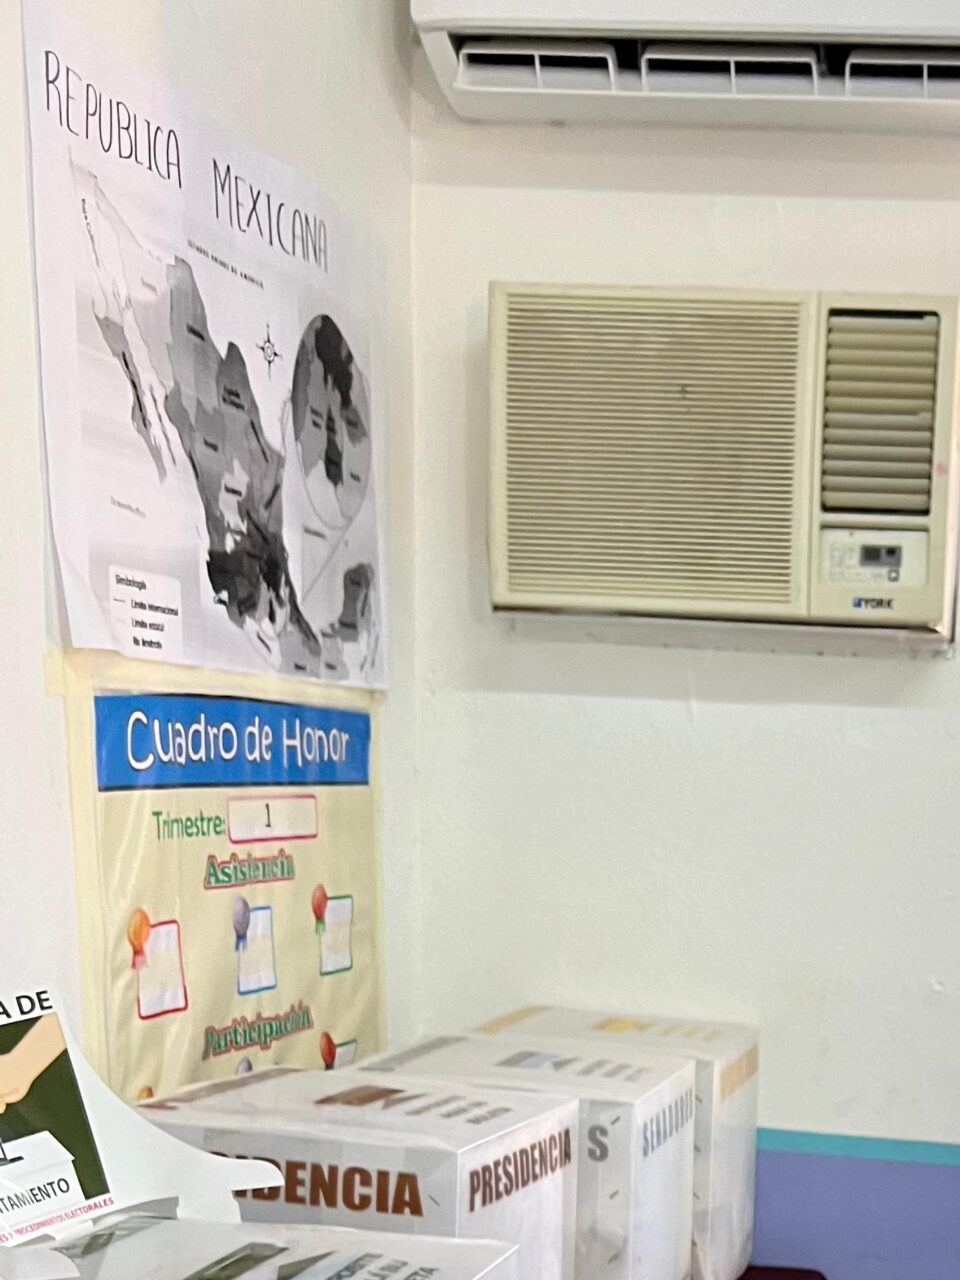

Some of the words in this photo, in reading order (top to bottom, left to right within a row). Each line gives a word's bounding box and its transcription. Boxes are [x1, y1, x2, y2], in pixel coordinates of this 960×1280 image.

[44, 50, 182, 189] REPUBLICA
[212, 157, 328, 274] MEXICANA
[127, 711, 238, 770] Cuadro
[244, 716, 273, 763] de
[282, 718, 349, 768] Honor
[152, 811, 226, 841] Trimestre:
[264, 803, 272, 828] 1
[204, 848, 295, 889] Asistencia
[15, 990, 53, 1016] DE
[202, 1000, 313, 1060] Participación
[469, 1127, 572, 1213] PRESIDENCIA
[0, 1178, 70, 1214] TAMIENTO
[64, 1197, 114, 1220] ELECTORALES
